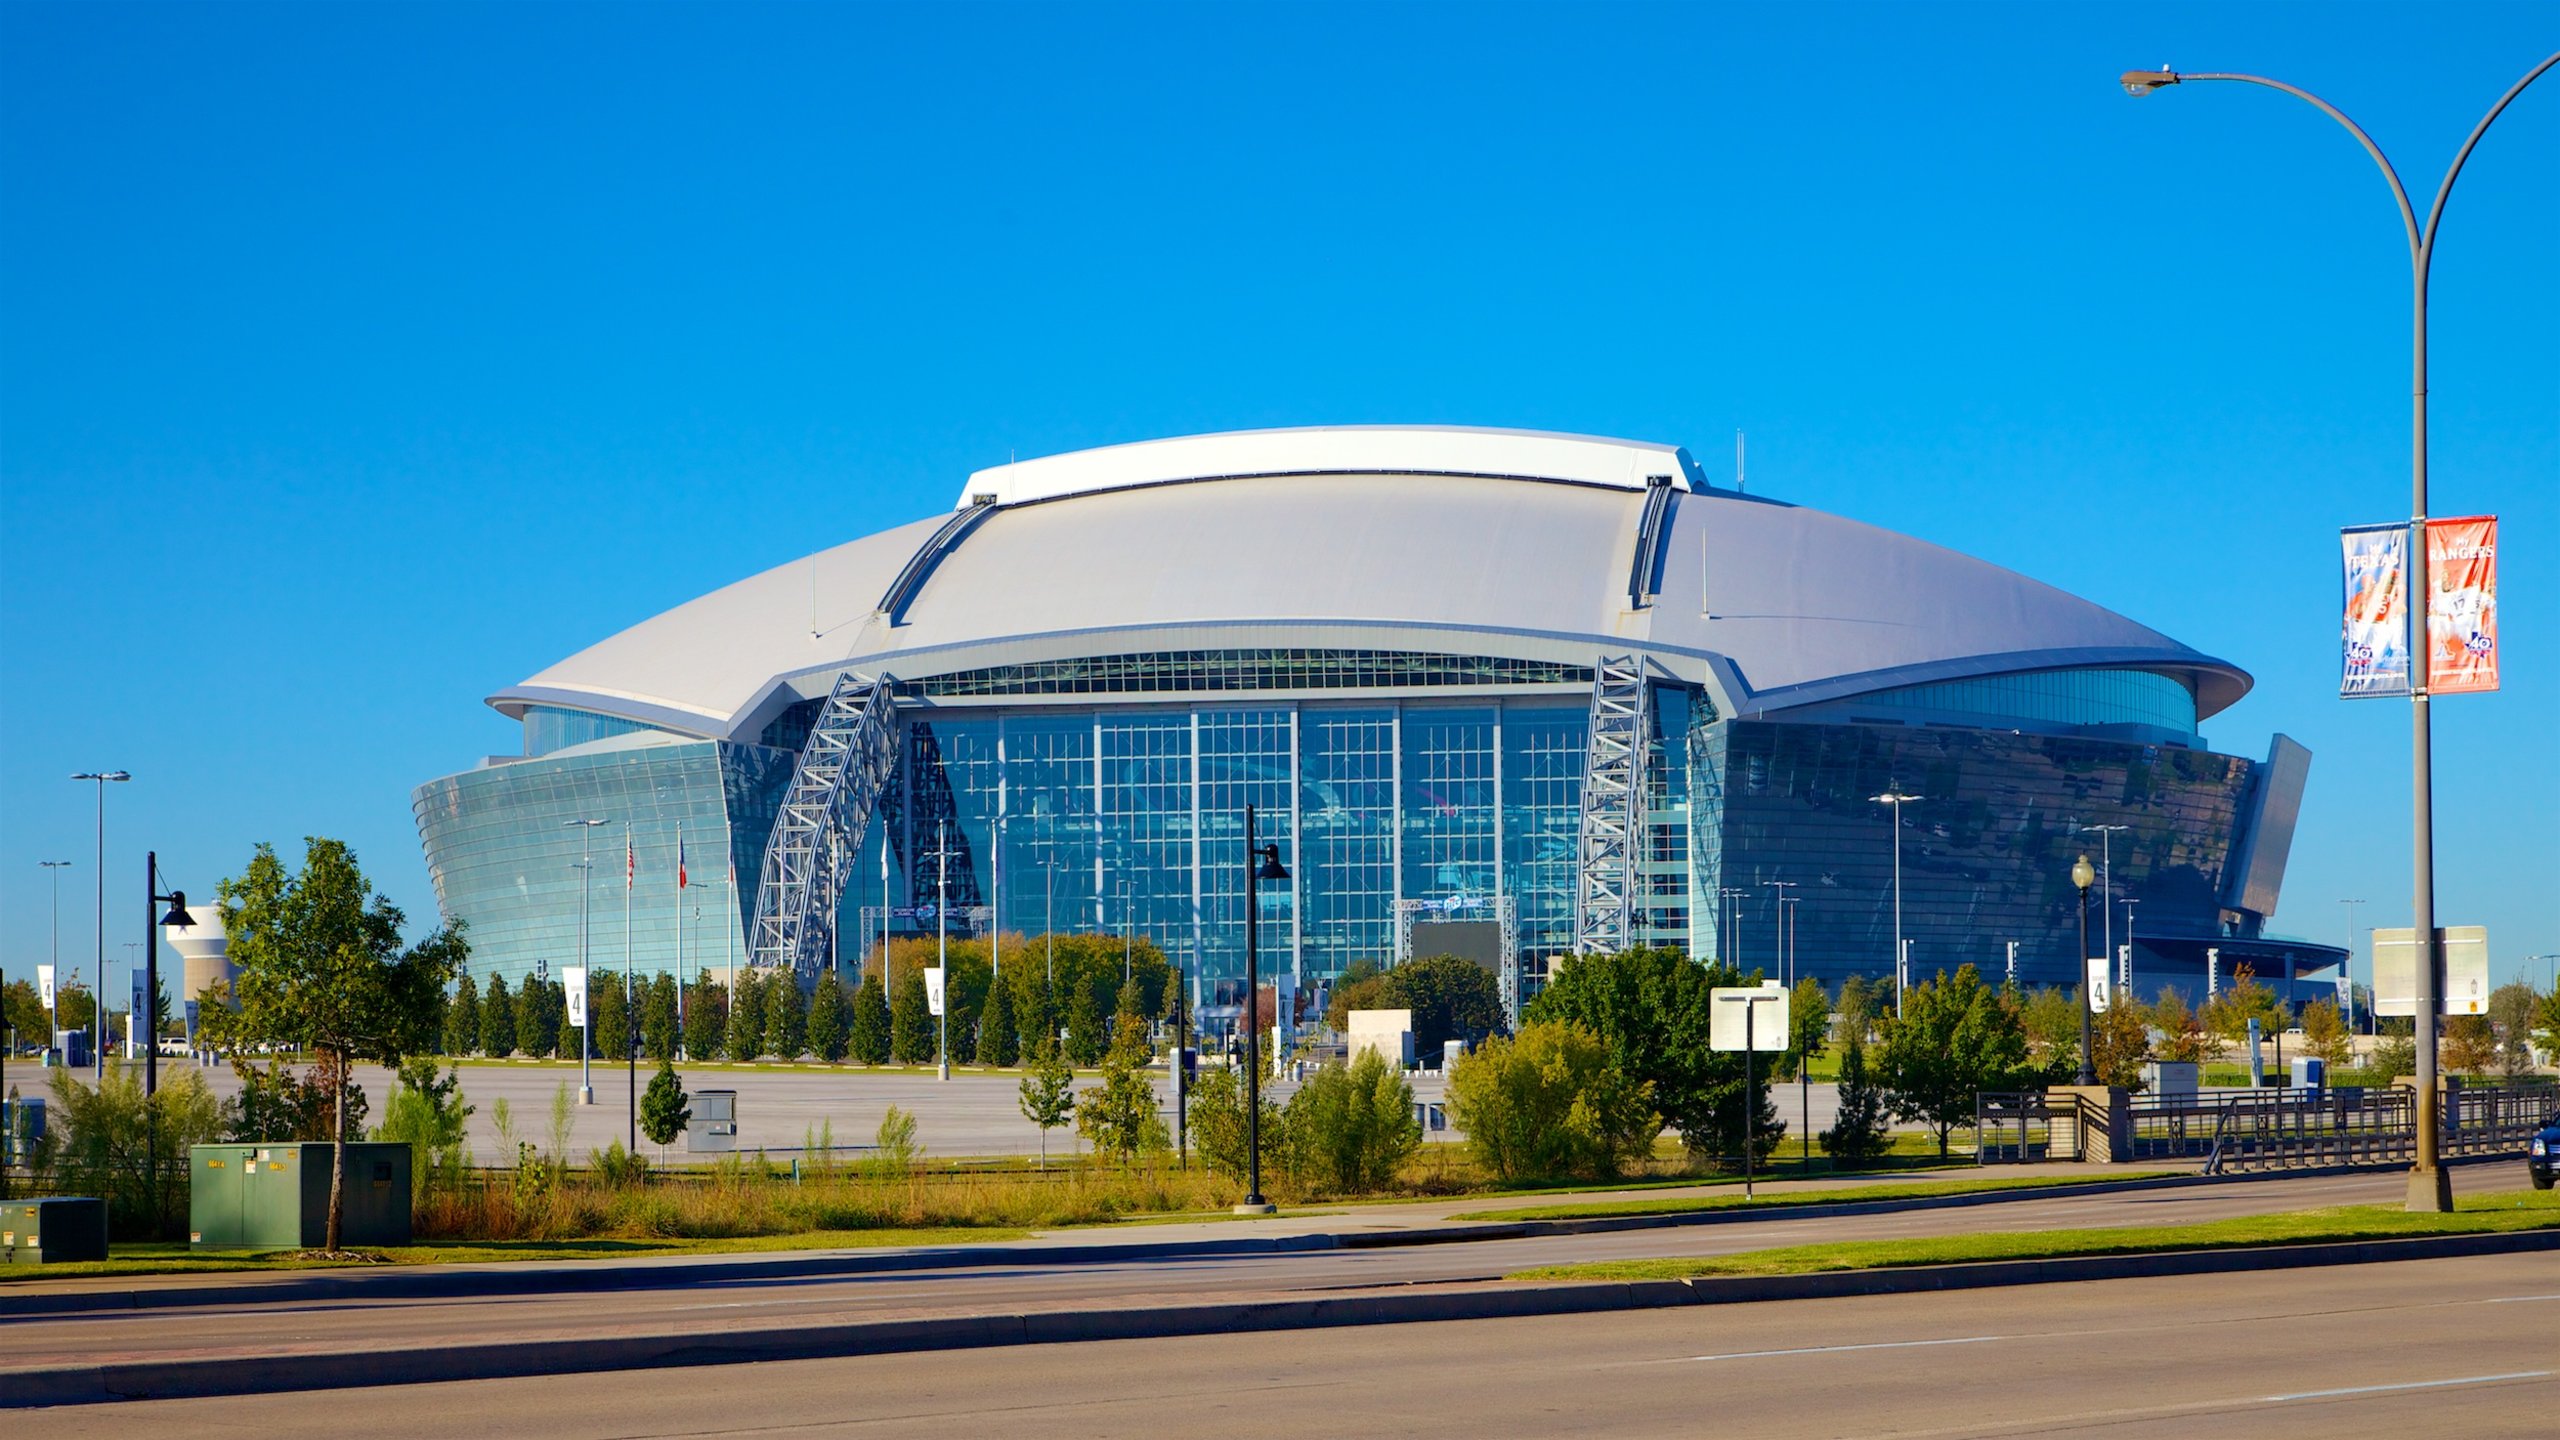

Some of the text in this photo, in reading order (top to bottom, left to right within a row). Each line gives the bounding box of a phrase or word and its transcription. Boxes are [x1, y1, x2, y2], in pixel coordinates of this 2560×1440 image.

[2468, 637, 2491, 650] 40
[45, 984, 51, 999] 4
[933, 988, 939, 1006] 4
[134, 993, 142, 1013] 4
[572, 993, 581, 1014] 4
